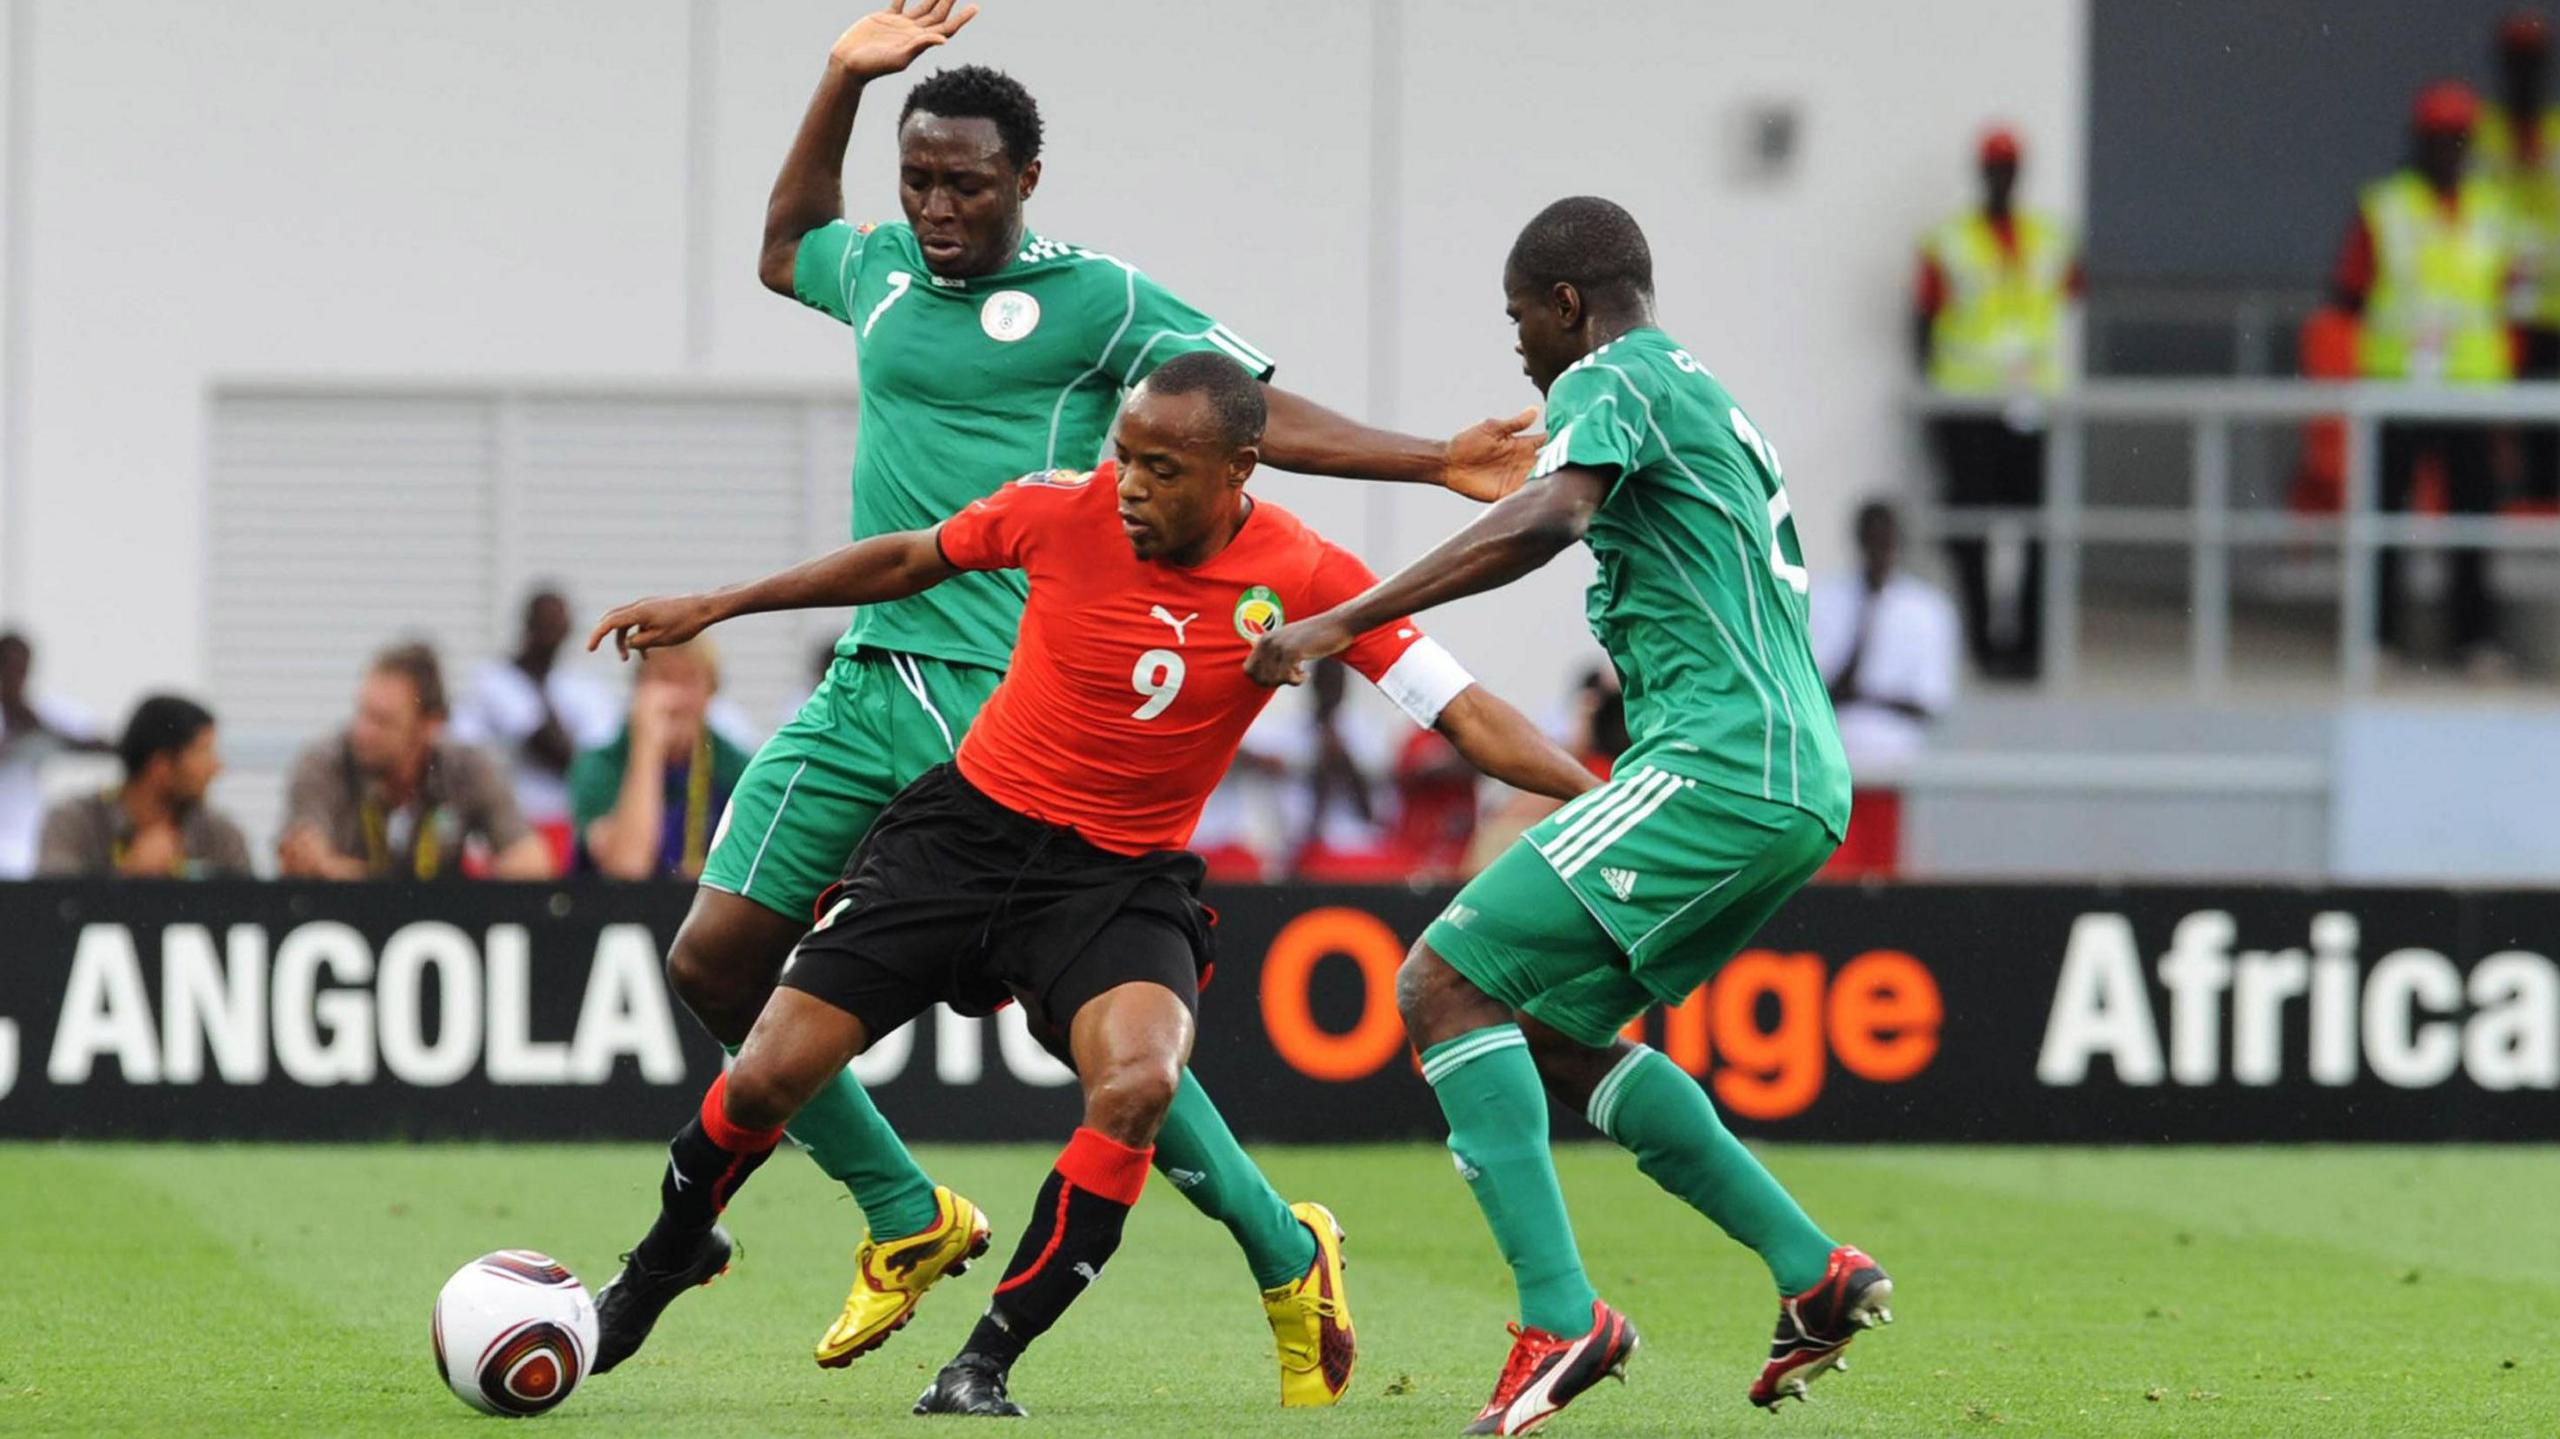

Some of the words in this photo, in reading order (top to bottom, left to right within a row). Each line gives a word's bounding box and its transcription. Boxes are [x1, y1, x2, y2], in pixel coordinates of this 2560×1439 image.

[862, 270, 912, 338] 7
[1131, 648, 1186, 721] 9
[46, 920, 687, 1086] ANGOLA
[1260, 906, 1943, 1120] Oge
[2036, 909, 2560, 1091] Africa
